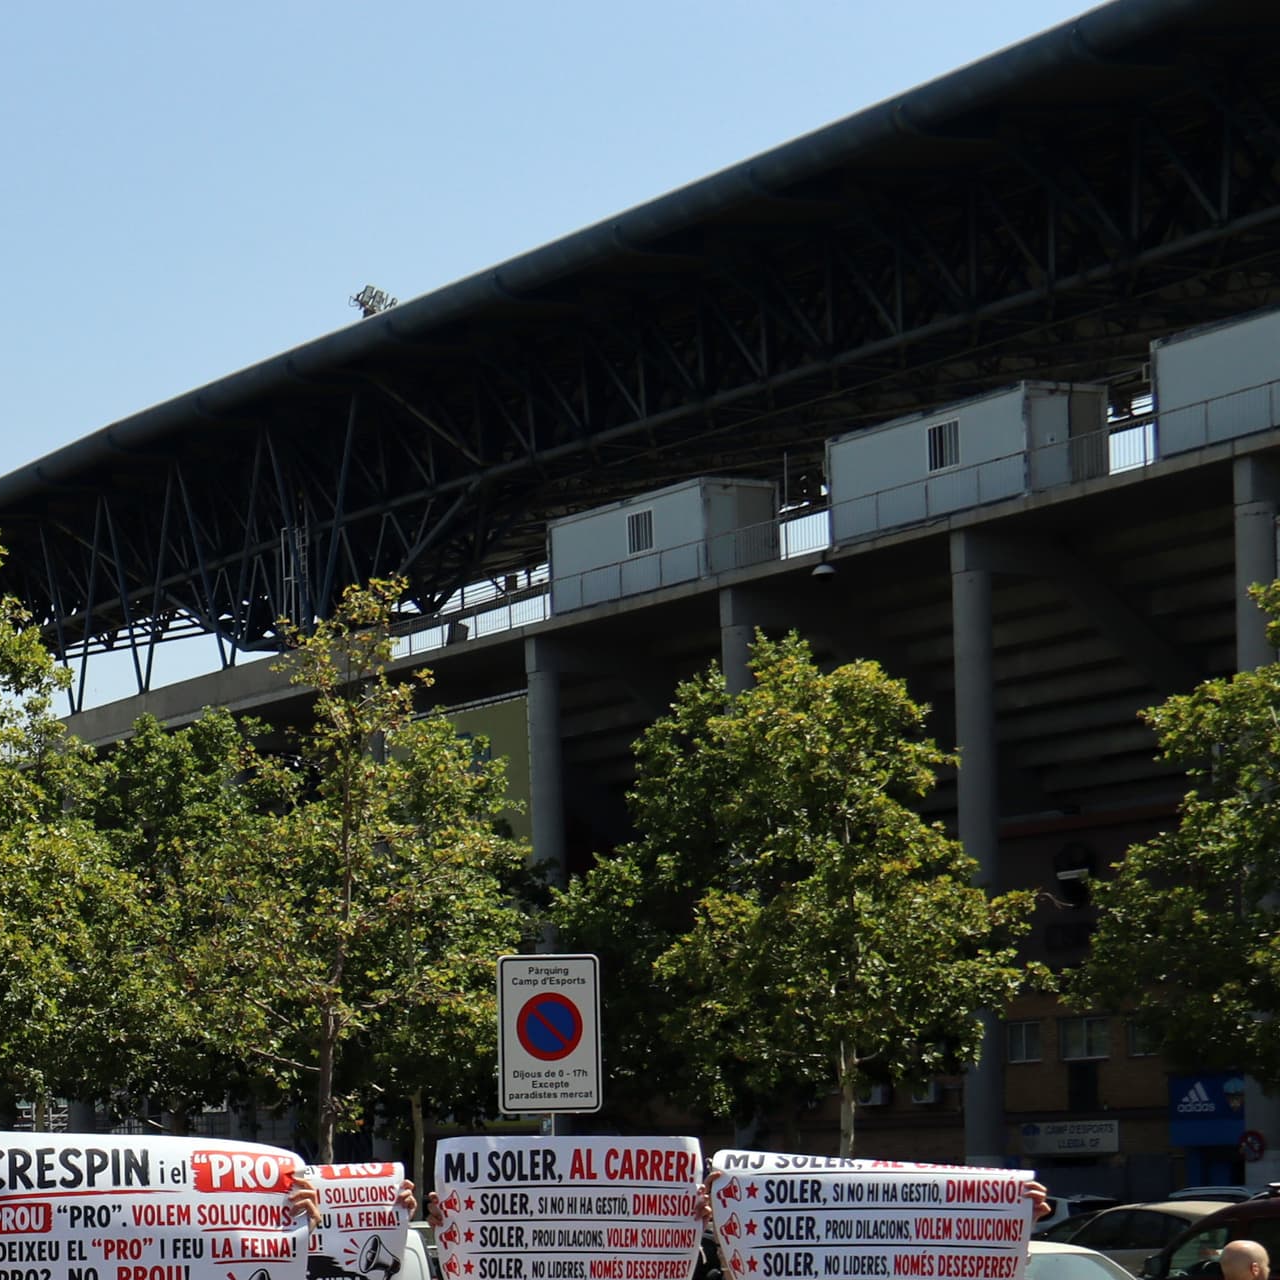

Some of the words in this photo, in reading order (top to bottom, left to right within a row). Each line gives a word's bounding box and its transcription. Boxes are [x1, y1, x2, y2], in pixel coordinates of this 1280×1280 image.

[512, 977, 538, 986] Camp
[541, 977, 585, 986] d'Esports
[513, 1070, 541, 1080] Dijous
[532, 1080, 569, 1090] Excepte
[509, 1092, 557, 1100] paradistes
[1177, 1103, 1216, 1112] adidas
[445, 1152, 479, 1183] MJ
[487, 1150, 562, 1183] SOLER,
[570, 1149, 597, 1180] AL
[605, 1148, 696, 1183] CARRER!
[765, 1180, 827, 1205] SOLER,
[833, 1184, 845, 1202] SI
[848, 1183, 863, 1202] NO
[868, 1184, 879, 1202] HI
[883, 1184, 898, 1202] HA
[901, 1180, 942, 1205] GESTIÓ,
[946, 1177, 1023, 1203] DIMISSIÓ!
[480, 1193, 533, 1217] SOLER,
[538, 1197, 548, 1214] SI
[551, 1197, 564, 1214] NO
[567, 1197, 577, 1214] HI
[580, 1197, 593, 1215] HA
[596, 1194, 629, 1216] GESTIÓ,
[633, 1191, 696, 1216] DIMISSIÓ!
[479, 1226, 528, 1250] SOLER,
[532, 1230, 555, 1247] PROU
[558, 1230, 605, 1250] DILACIONS,
[607, 1228, 637, 1248] VOLEM
[641, 1228, 696, 1248] SOLUCIONS!
[763, 1216, 820, 1242] SOLER,
[825, 1220, 852, 1238] PROU
[855, 1220, 911, 1241] DILACIONS,
[915, 1218, 952, 1239] VOLEM
[956, 1219, 1022, 1241] SOLUCIONS!
[479, 1258, 527, 1280] SOLER,
[532, 1261, 546, 1278] NO
[548, 1261, 587, 1280] LIDERES,
[590, 1257, 623, 1279] NOMÉS
[626, 1260, 690, 1279] DESESPERES!
